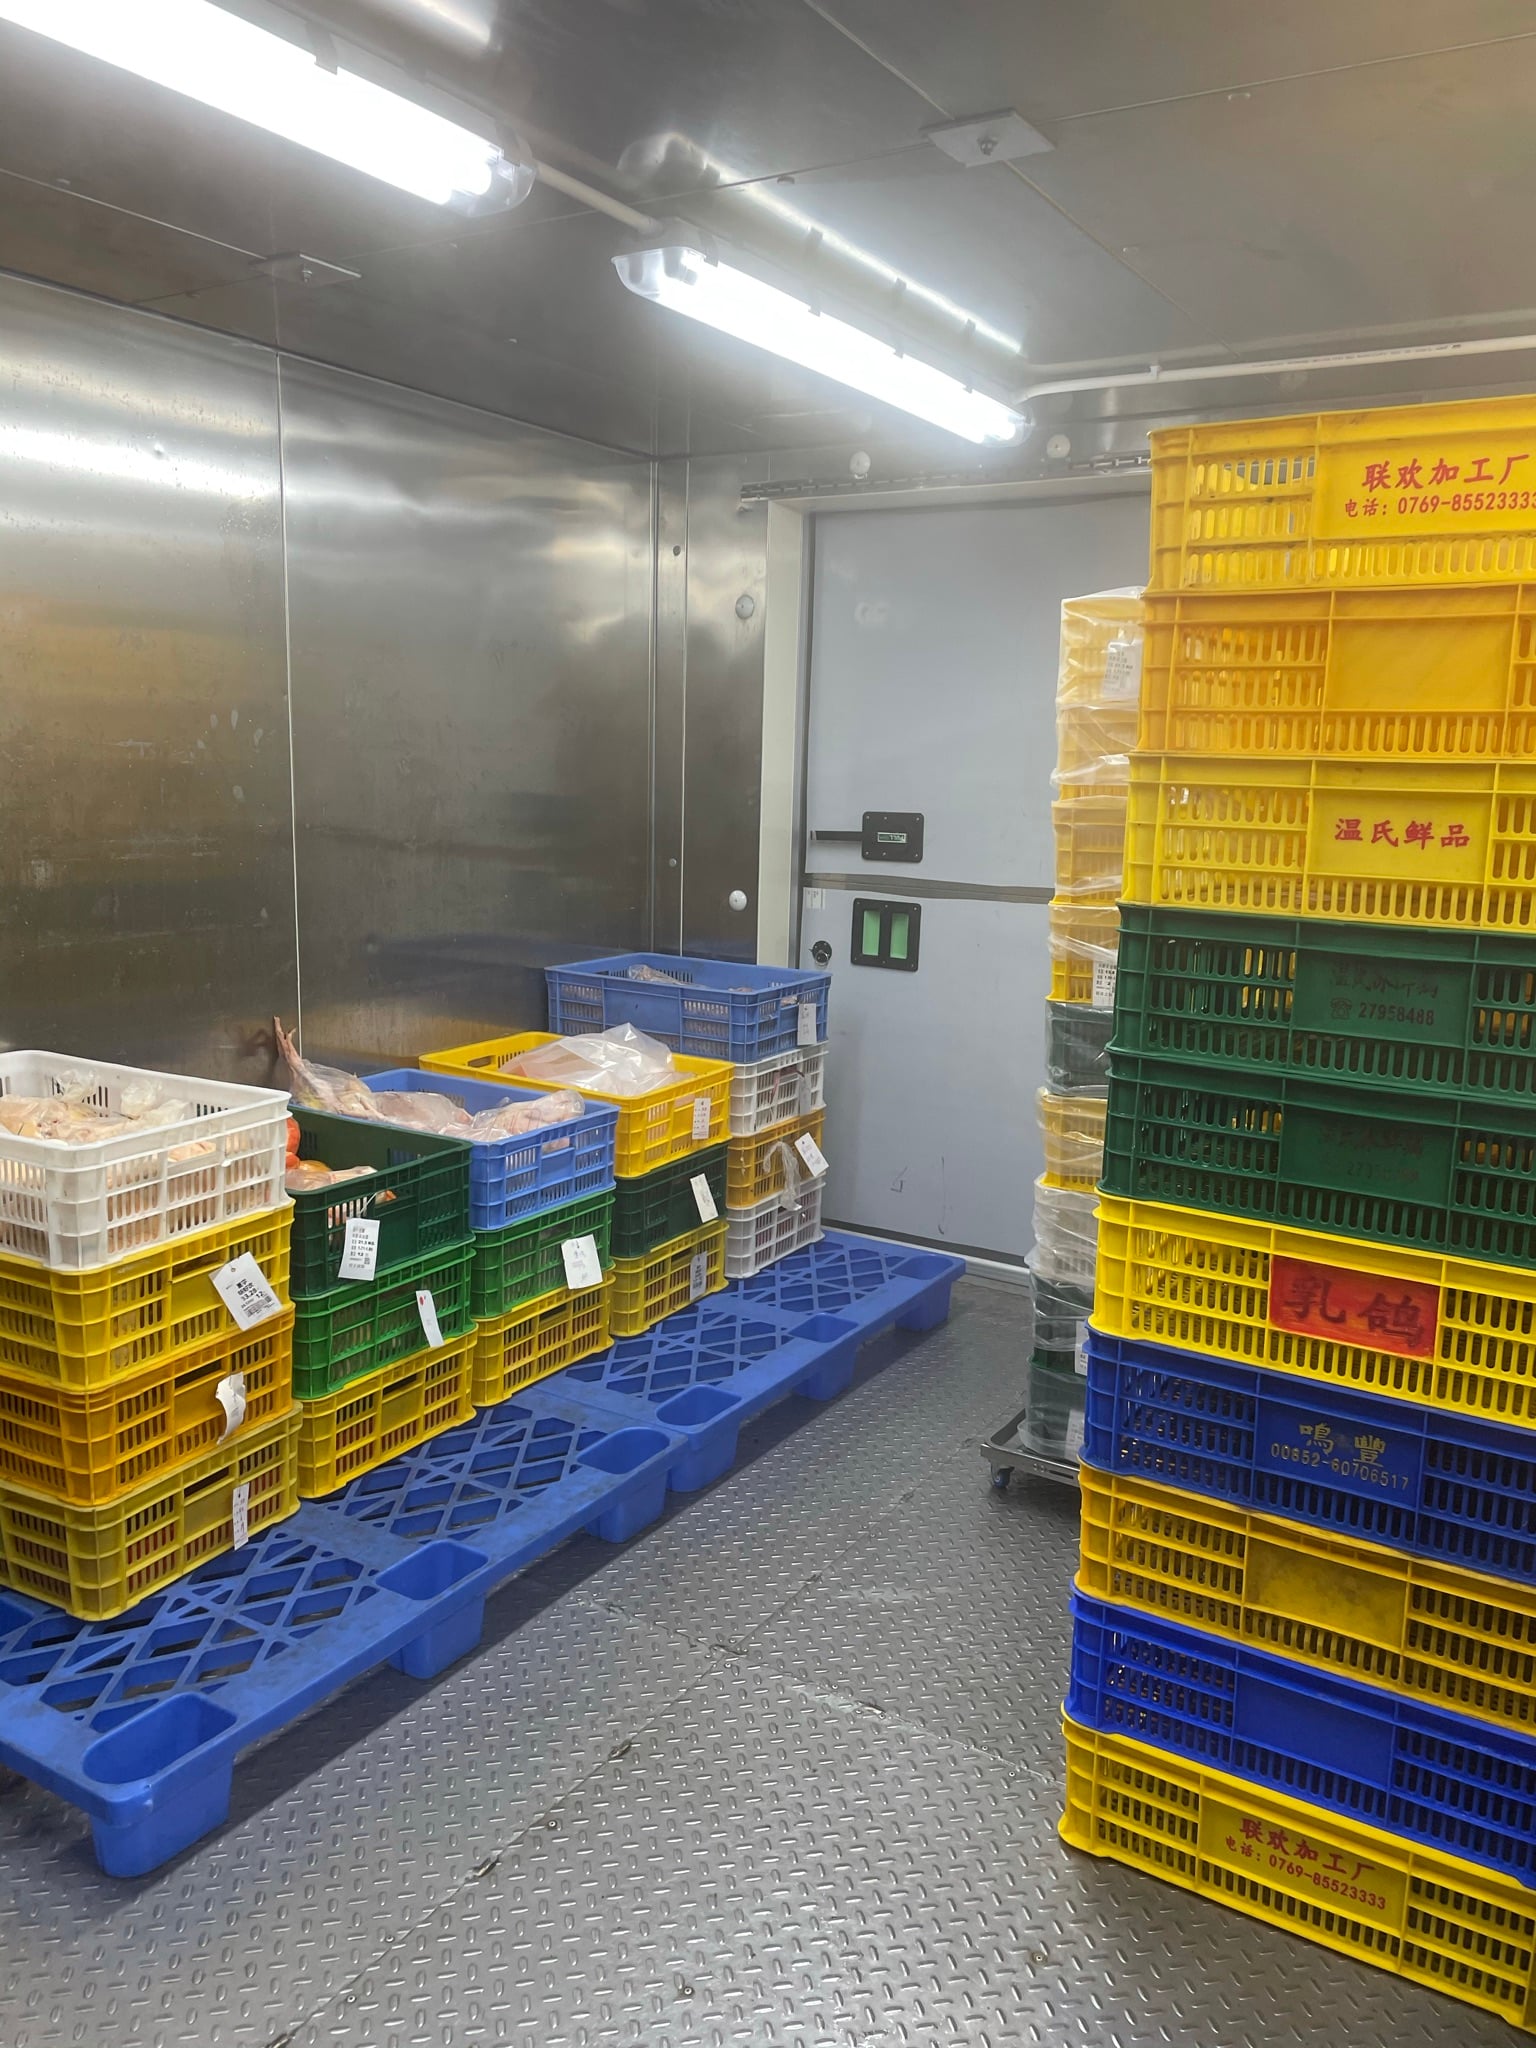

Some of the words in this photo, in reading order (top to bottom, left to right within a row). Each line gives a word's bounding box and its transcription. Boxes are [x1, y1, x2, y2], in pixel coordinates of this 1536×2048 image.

[1362, 454, 1530, 493] 联欢加工厂
[1334, 818, 1470, 850] 温氏鲜品
[1271, 1443, 1409, 1490] 00852-60706517
[1240, 1817, 1376, 1881] 联欢加工厂
[1269, 1854, 1387, 1911] 0769-85523333
